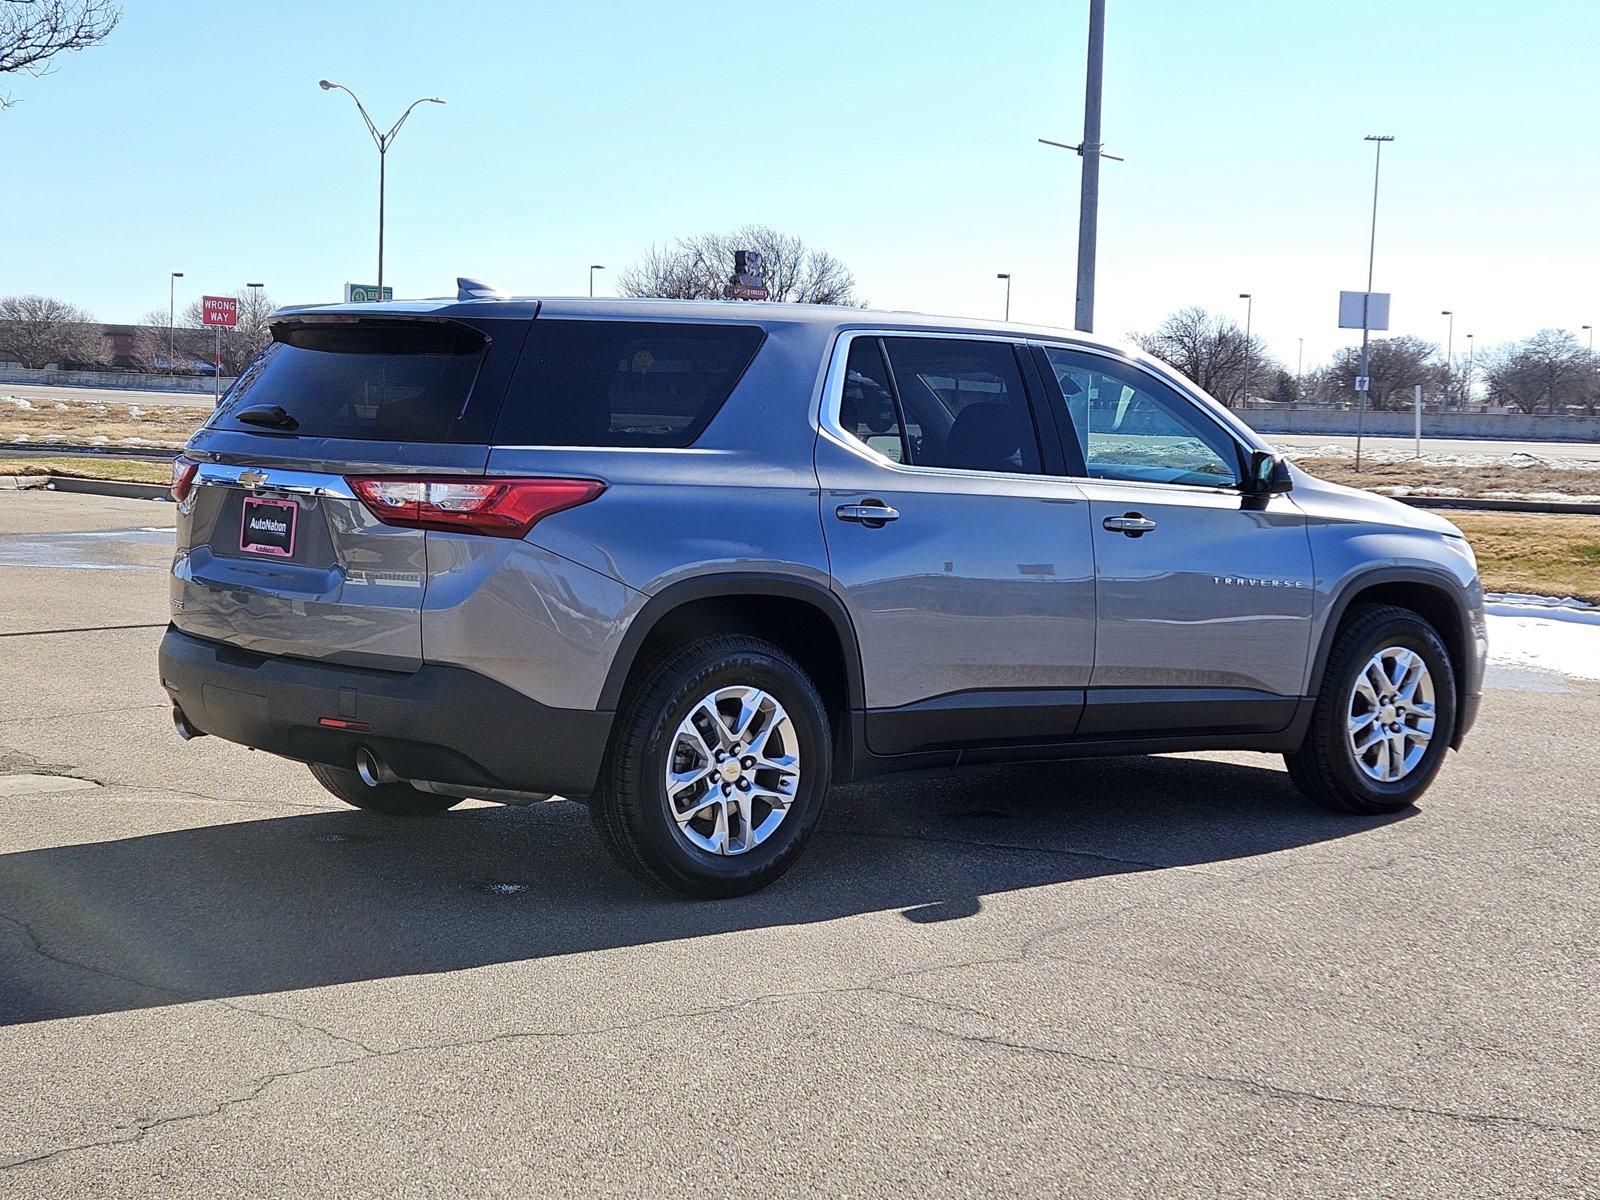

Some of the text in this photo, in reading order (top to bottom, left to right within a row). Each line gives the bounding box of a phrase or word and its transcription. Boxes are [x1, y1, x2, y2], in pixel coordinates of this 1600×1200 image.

[204, 300, 235, 311] WRONG
[210, 311, 229, 322] WAY
[249, 517, 287, 532] AutoNation
[1213, 577, 1303, 589] TRAVERSE
